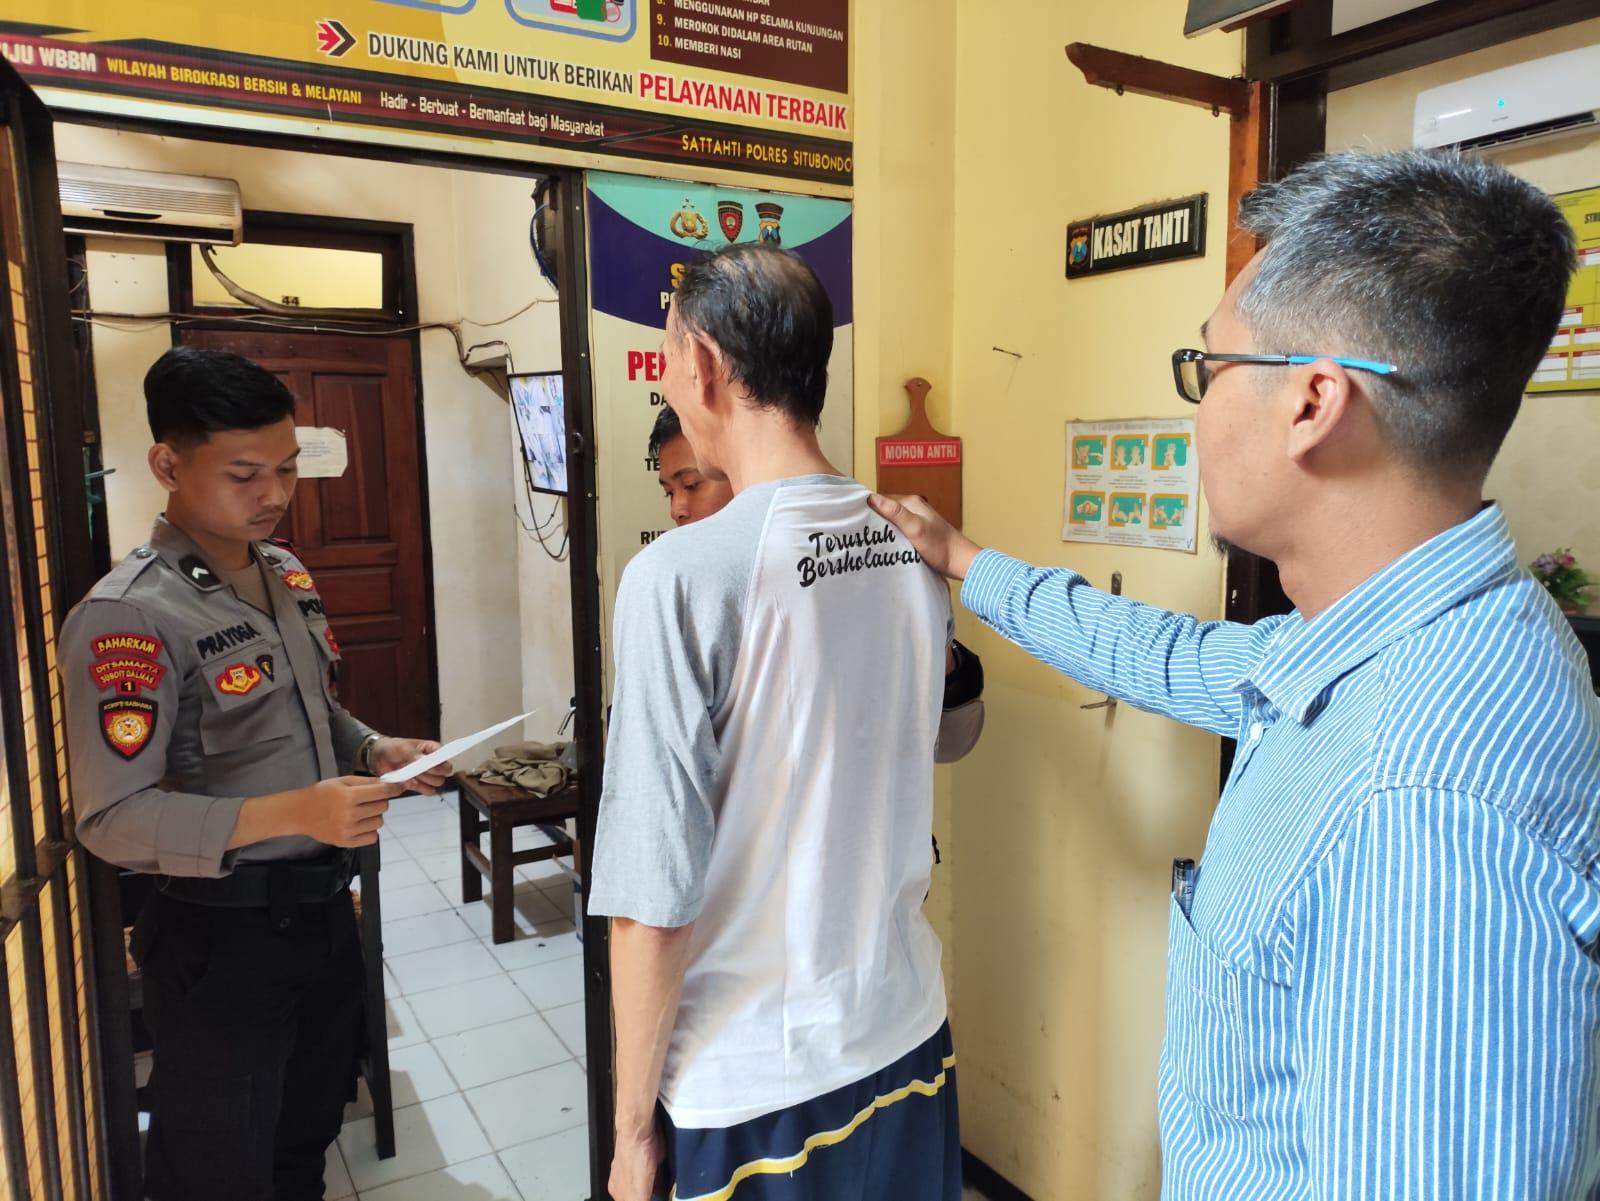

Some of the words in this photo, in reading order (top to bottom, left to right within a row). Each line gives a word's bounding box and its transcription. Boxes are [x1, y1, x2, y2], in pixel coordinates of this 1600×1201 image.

[656, 14, 666, 26] 9.
[674, 17, 720, 35] MEROKOK
[721, 27, 761, 43] DIDALAM
[762, 34, 785, 47] AREA
[786, 38, 813, 53] RUTAN
[674, 0, 745, 20] MENGGUNAKAN
[747, 12, 759, 23] HP
[760, 14, 794, 31] SELAMA
[795, 22, 844, 41] KUNJUNGAN
[657, 35, 672, 47] 10.
[674, 37, 719, 55] MEMBERI
[720, 46, 742, 59] NASI
[39, 46, 97, 72] WBBM
[106, 57, 167, 82] WILAYAH
[170, 66, 240, 89] BIROKRASI
[243, 75, 288, 97] BERSIH
[291, 83, 302, 97] &
[305, 85, 362, 106] MELAYANI
[368, 33, 448, 66] DUKUNG
[453, 46, 498, 73] KAMI
[504, 54, 560, 83] UNTUK
[564, 64, 633, 94] BERIKAN
[639, 72, 761, 116] PELAYANAN
[766, 93, 847, 130] TERBAIK
[380, 91, 409, 111] Hadir
[419, 96, 459, 117] Berbuat
[469, 103, 526, 126] Bermanfaat
[528, 114, 548, 132] bagi
[550, 115, 605, 137] Masyarakat
[682, 135, 741, 158] SATTAHTI
[746, 143, 788, 165] POLRES
[793, 151, 852, 173] SITUBONDO
[1093, 218, 1142, 261] KASAT
[1143, 208, 1191, 250] TAHTI
[281, 295, 301, 307] 44
[885, 444, 925, 460] MOHON
[927, 444, 958, 459] ANTRI
[808, 523, 896, 558] Teruslah
[97, 637, 156, 653] BAHARKAM
[196, 621, 262, 660] PRAYOGA
[124, 681, 133, 691] 1
